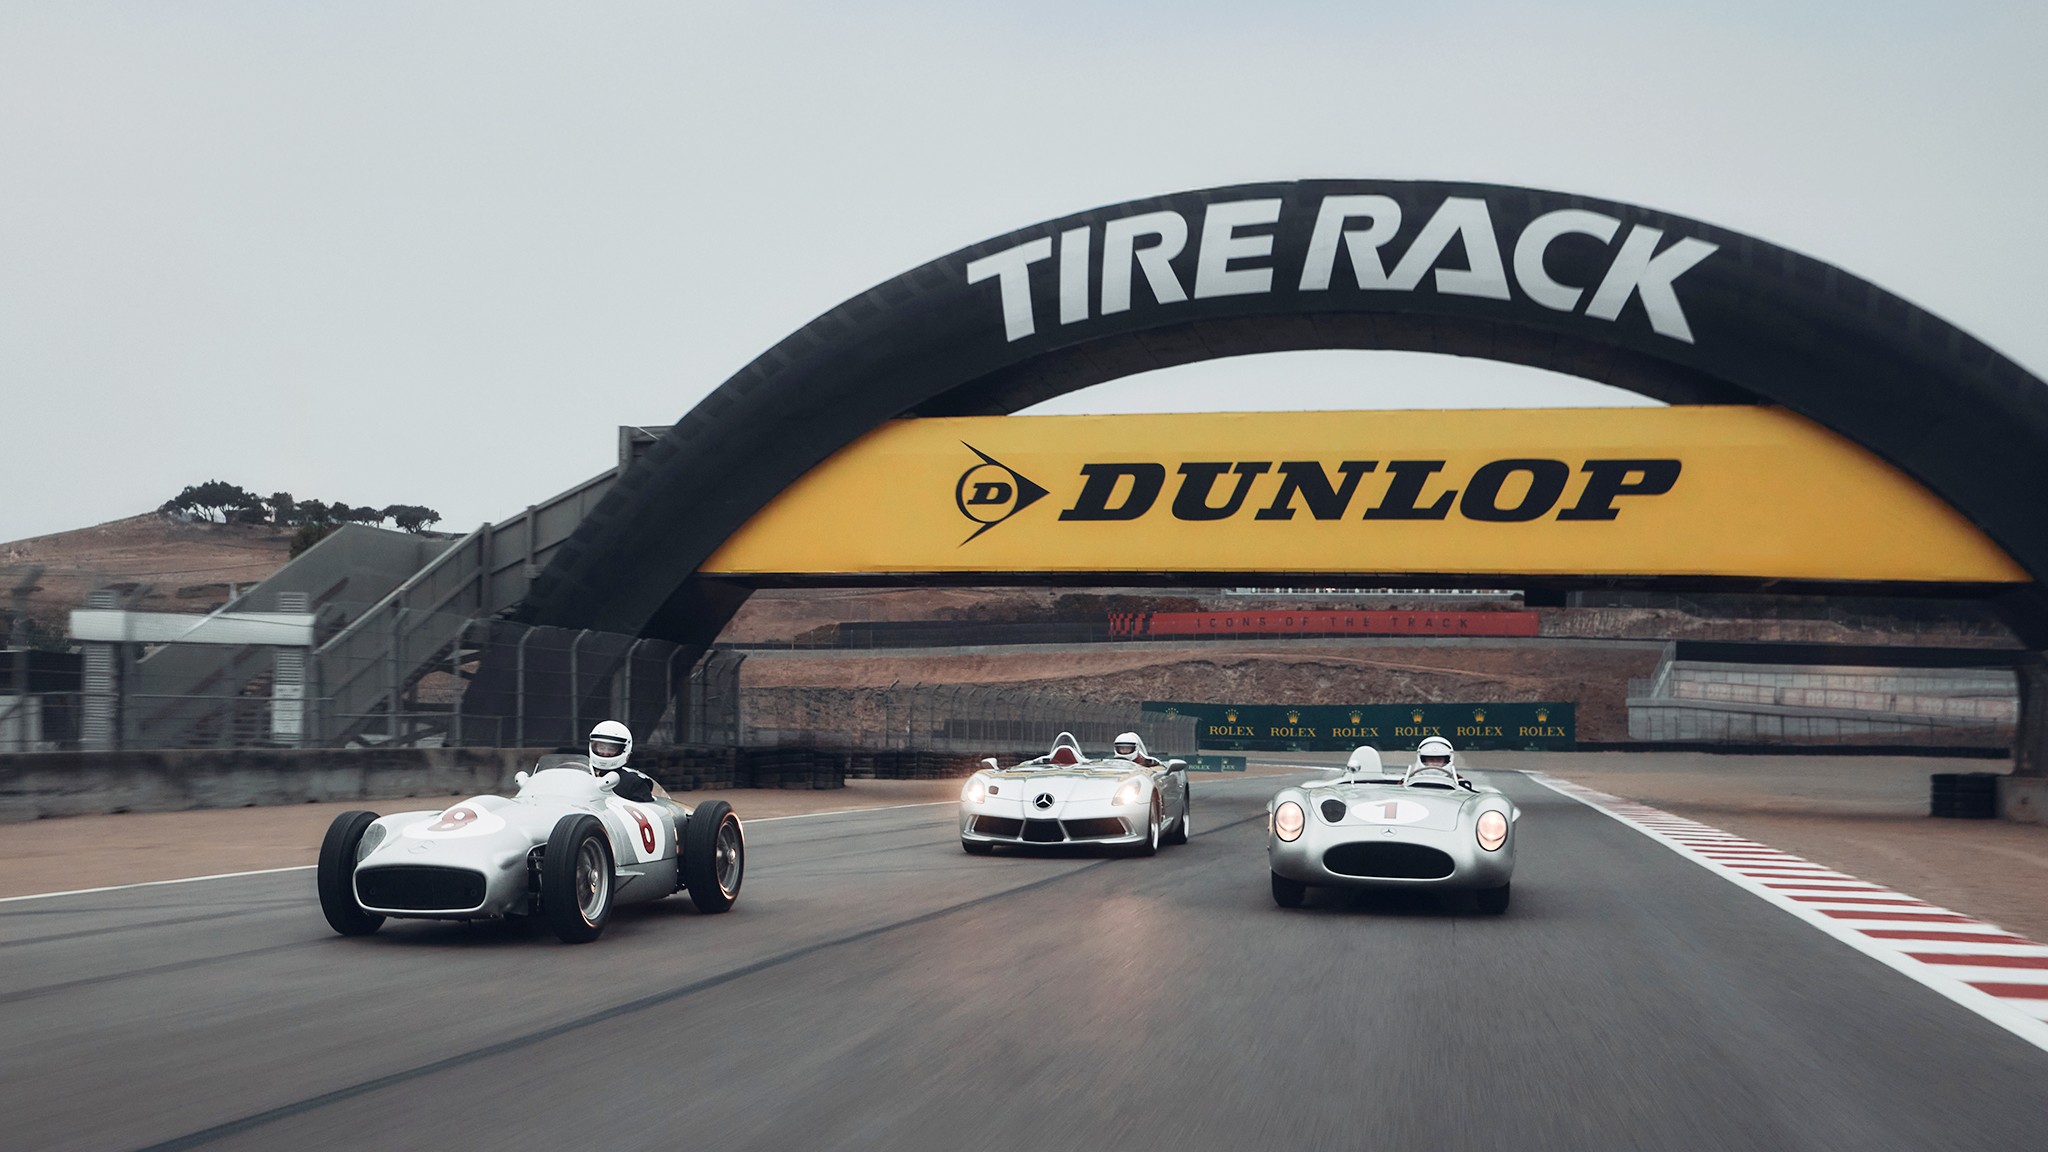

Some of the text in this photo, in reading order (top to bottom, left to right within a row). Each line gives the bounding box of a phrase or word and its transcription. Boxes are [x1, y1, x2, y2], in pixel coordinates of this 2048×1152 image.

[967, 194, 1721, 344] TIRE RACK
[966, 458, 1684, 522] D DUNLOP
[1196, 615, 1469, 629] ICONS OF THE TRACK
[1209, 725, 1255, 737] ROLEX
[1270, 726, 1317, 738] ROLEX
[1332, 727, 1379, 738] ROLEX
[1394, 726, 1441, 737] ROLEX
[1456, 726, 1503, 737] ROLEX
[1518, 726, 1566, 737] ROLEX
[1374, 801, 1398, 820] 1
[427, 807, 478, 832] 8
[623, 804, 656, 855] 8
